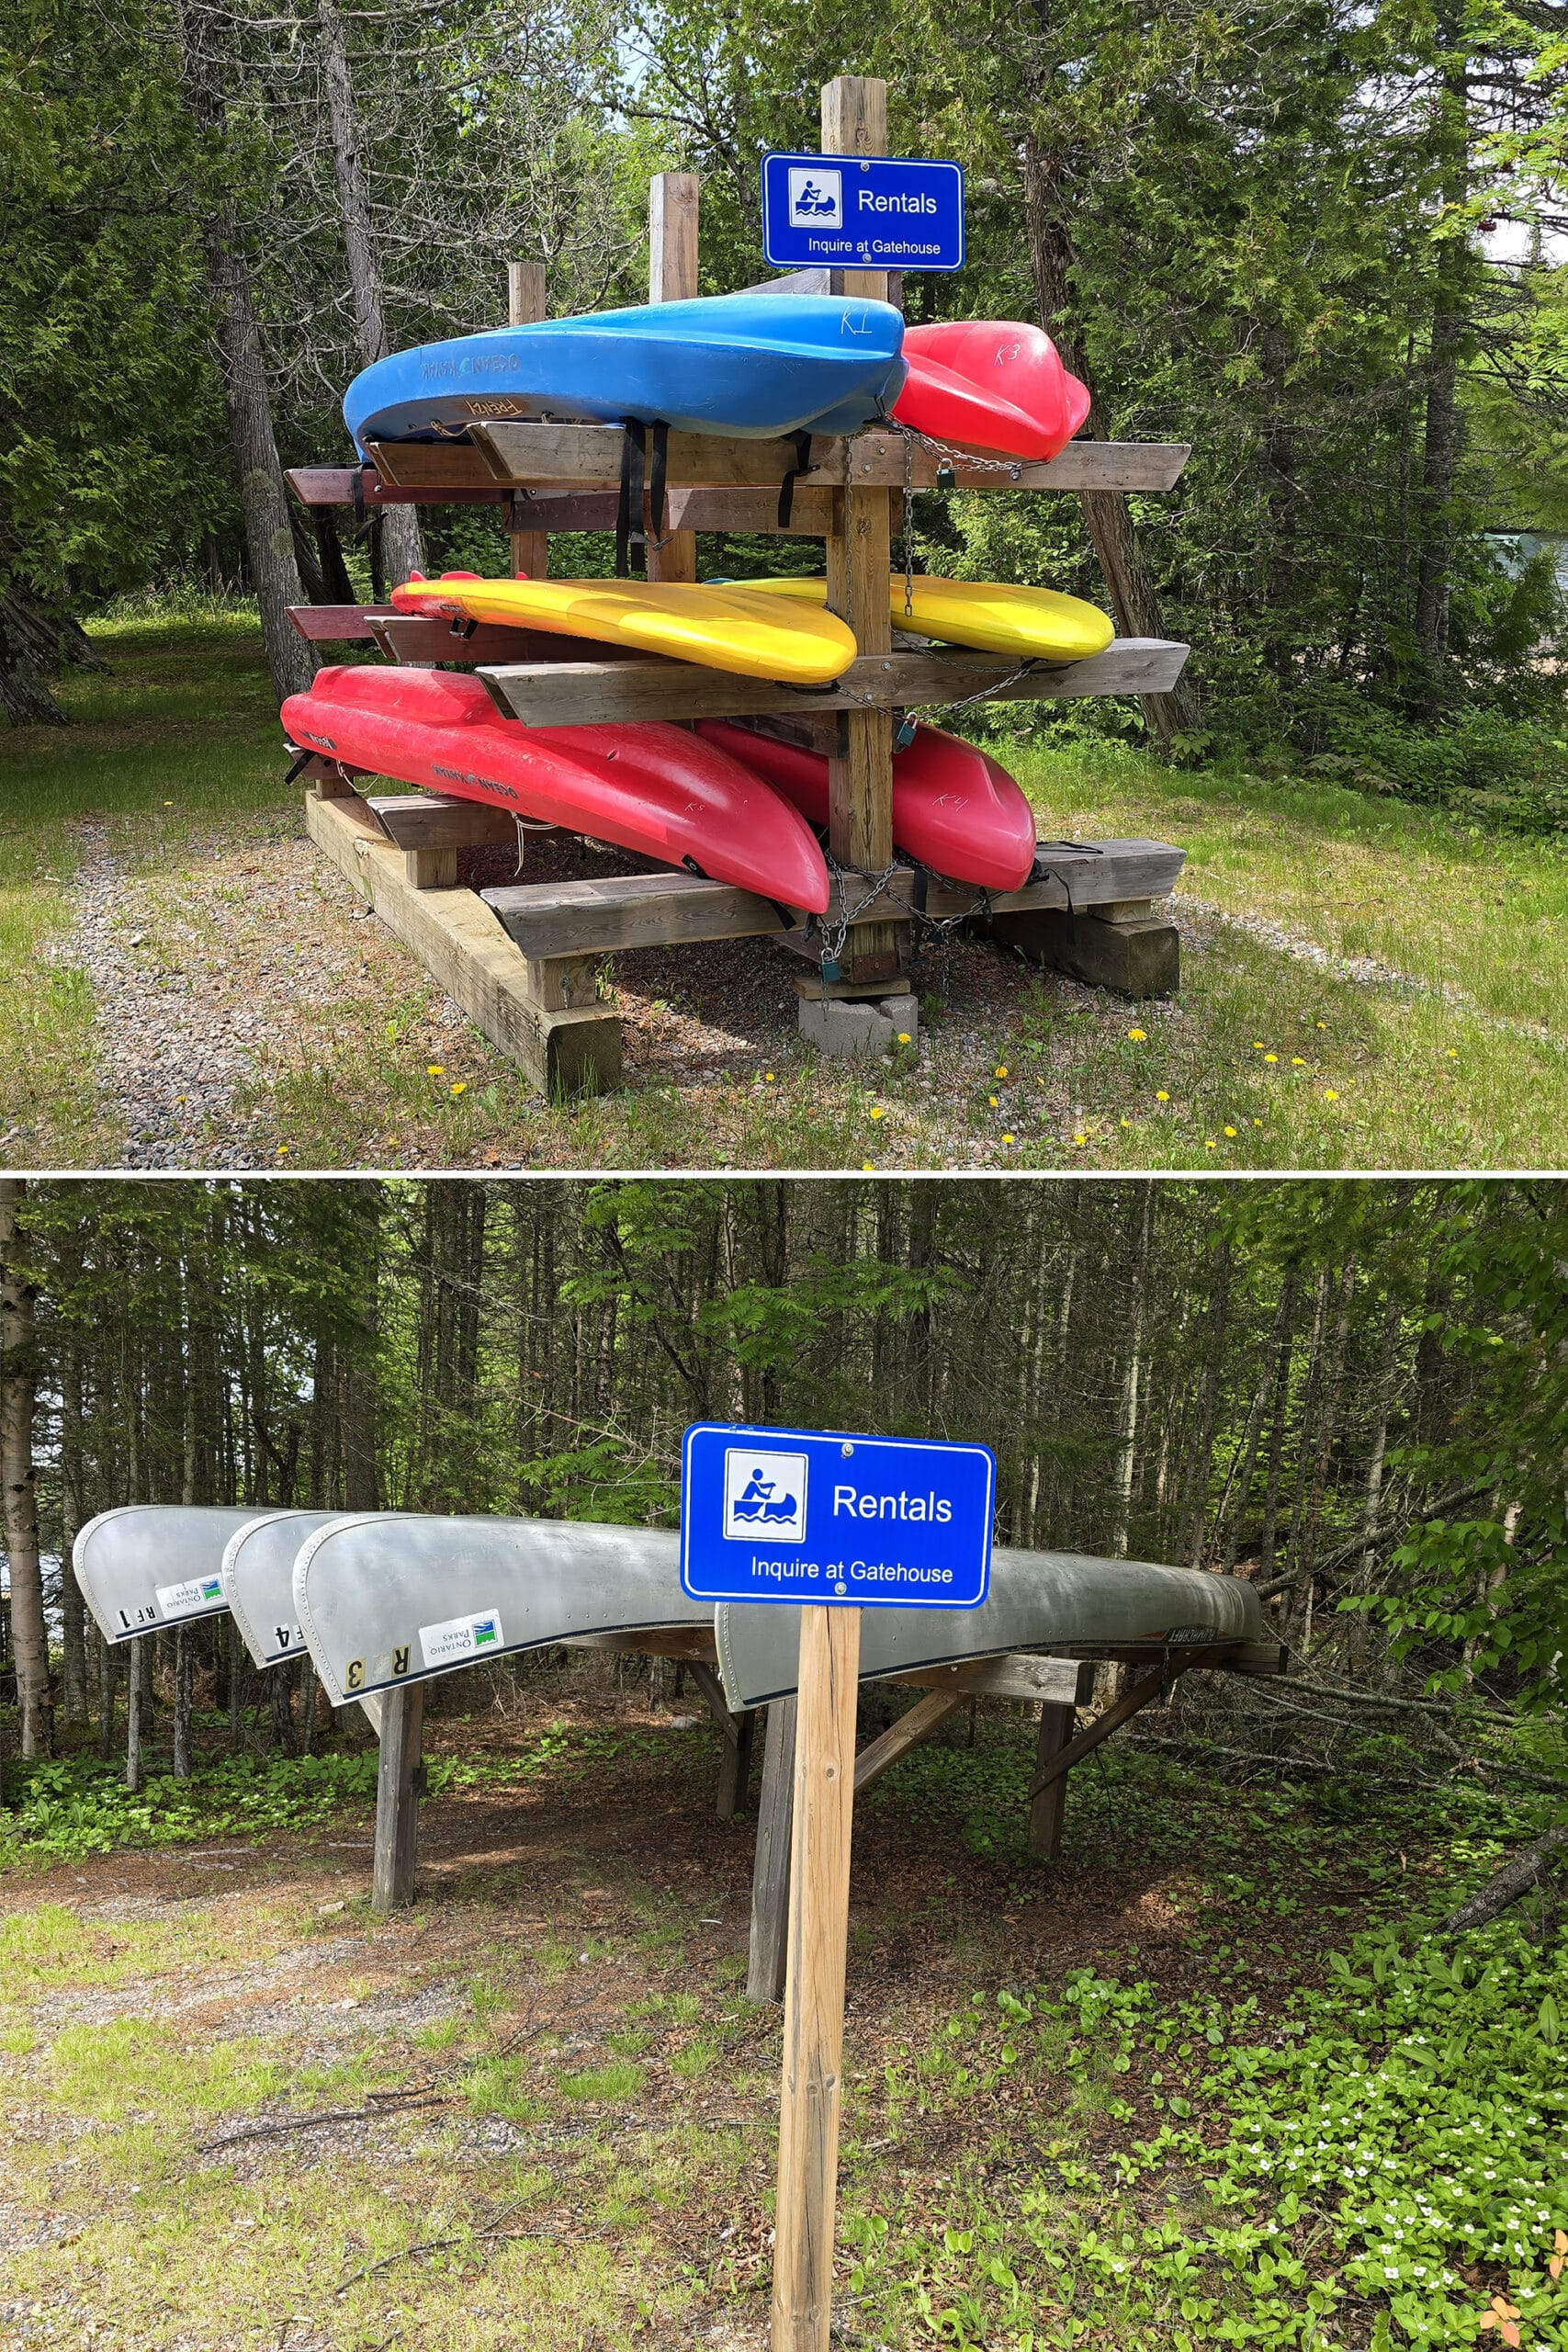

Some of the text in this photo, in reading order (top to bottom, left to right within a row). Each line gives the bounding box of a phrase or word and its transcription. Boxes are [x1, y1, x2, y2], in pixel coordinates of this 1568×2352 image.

[858, 189, 938, 214] Rentals
[808, 237, 942, 255] Inquire at Gatehouse
[471, 353, 521, 374] OCEAN
[993, 344, 1021, 367] K3
[464, 398, 523, 416] FRENZY
[477, 776, 519, 800] OCEAN
[833, 1485, 953, 1523] Rentals
[751, 1555, 953, 1584] Inquire at Gatehouse
[166, 1594, 201, 1609] ONTARIO
[175, 1588, 199, 1599] PARKS
[275, 1626, 290, 1648] 4
[442, 1629, 469, 1642] PARKS
[430, 1639, 471, 1656] ONTARIO
[348, 1646, 410, 1689] R 3
